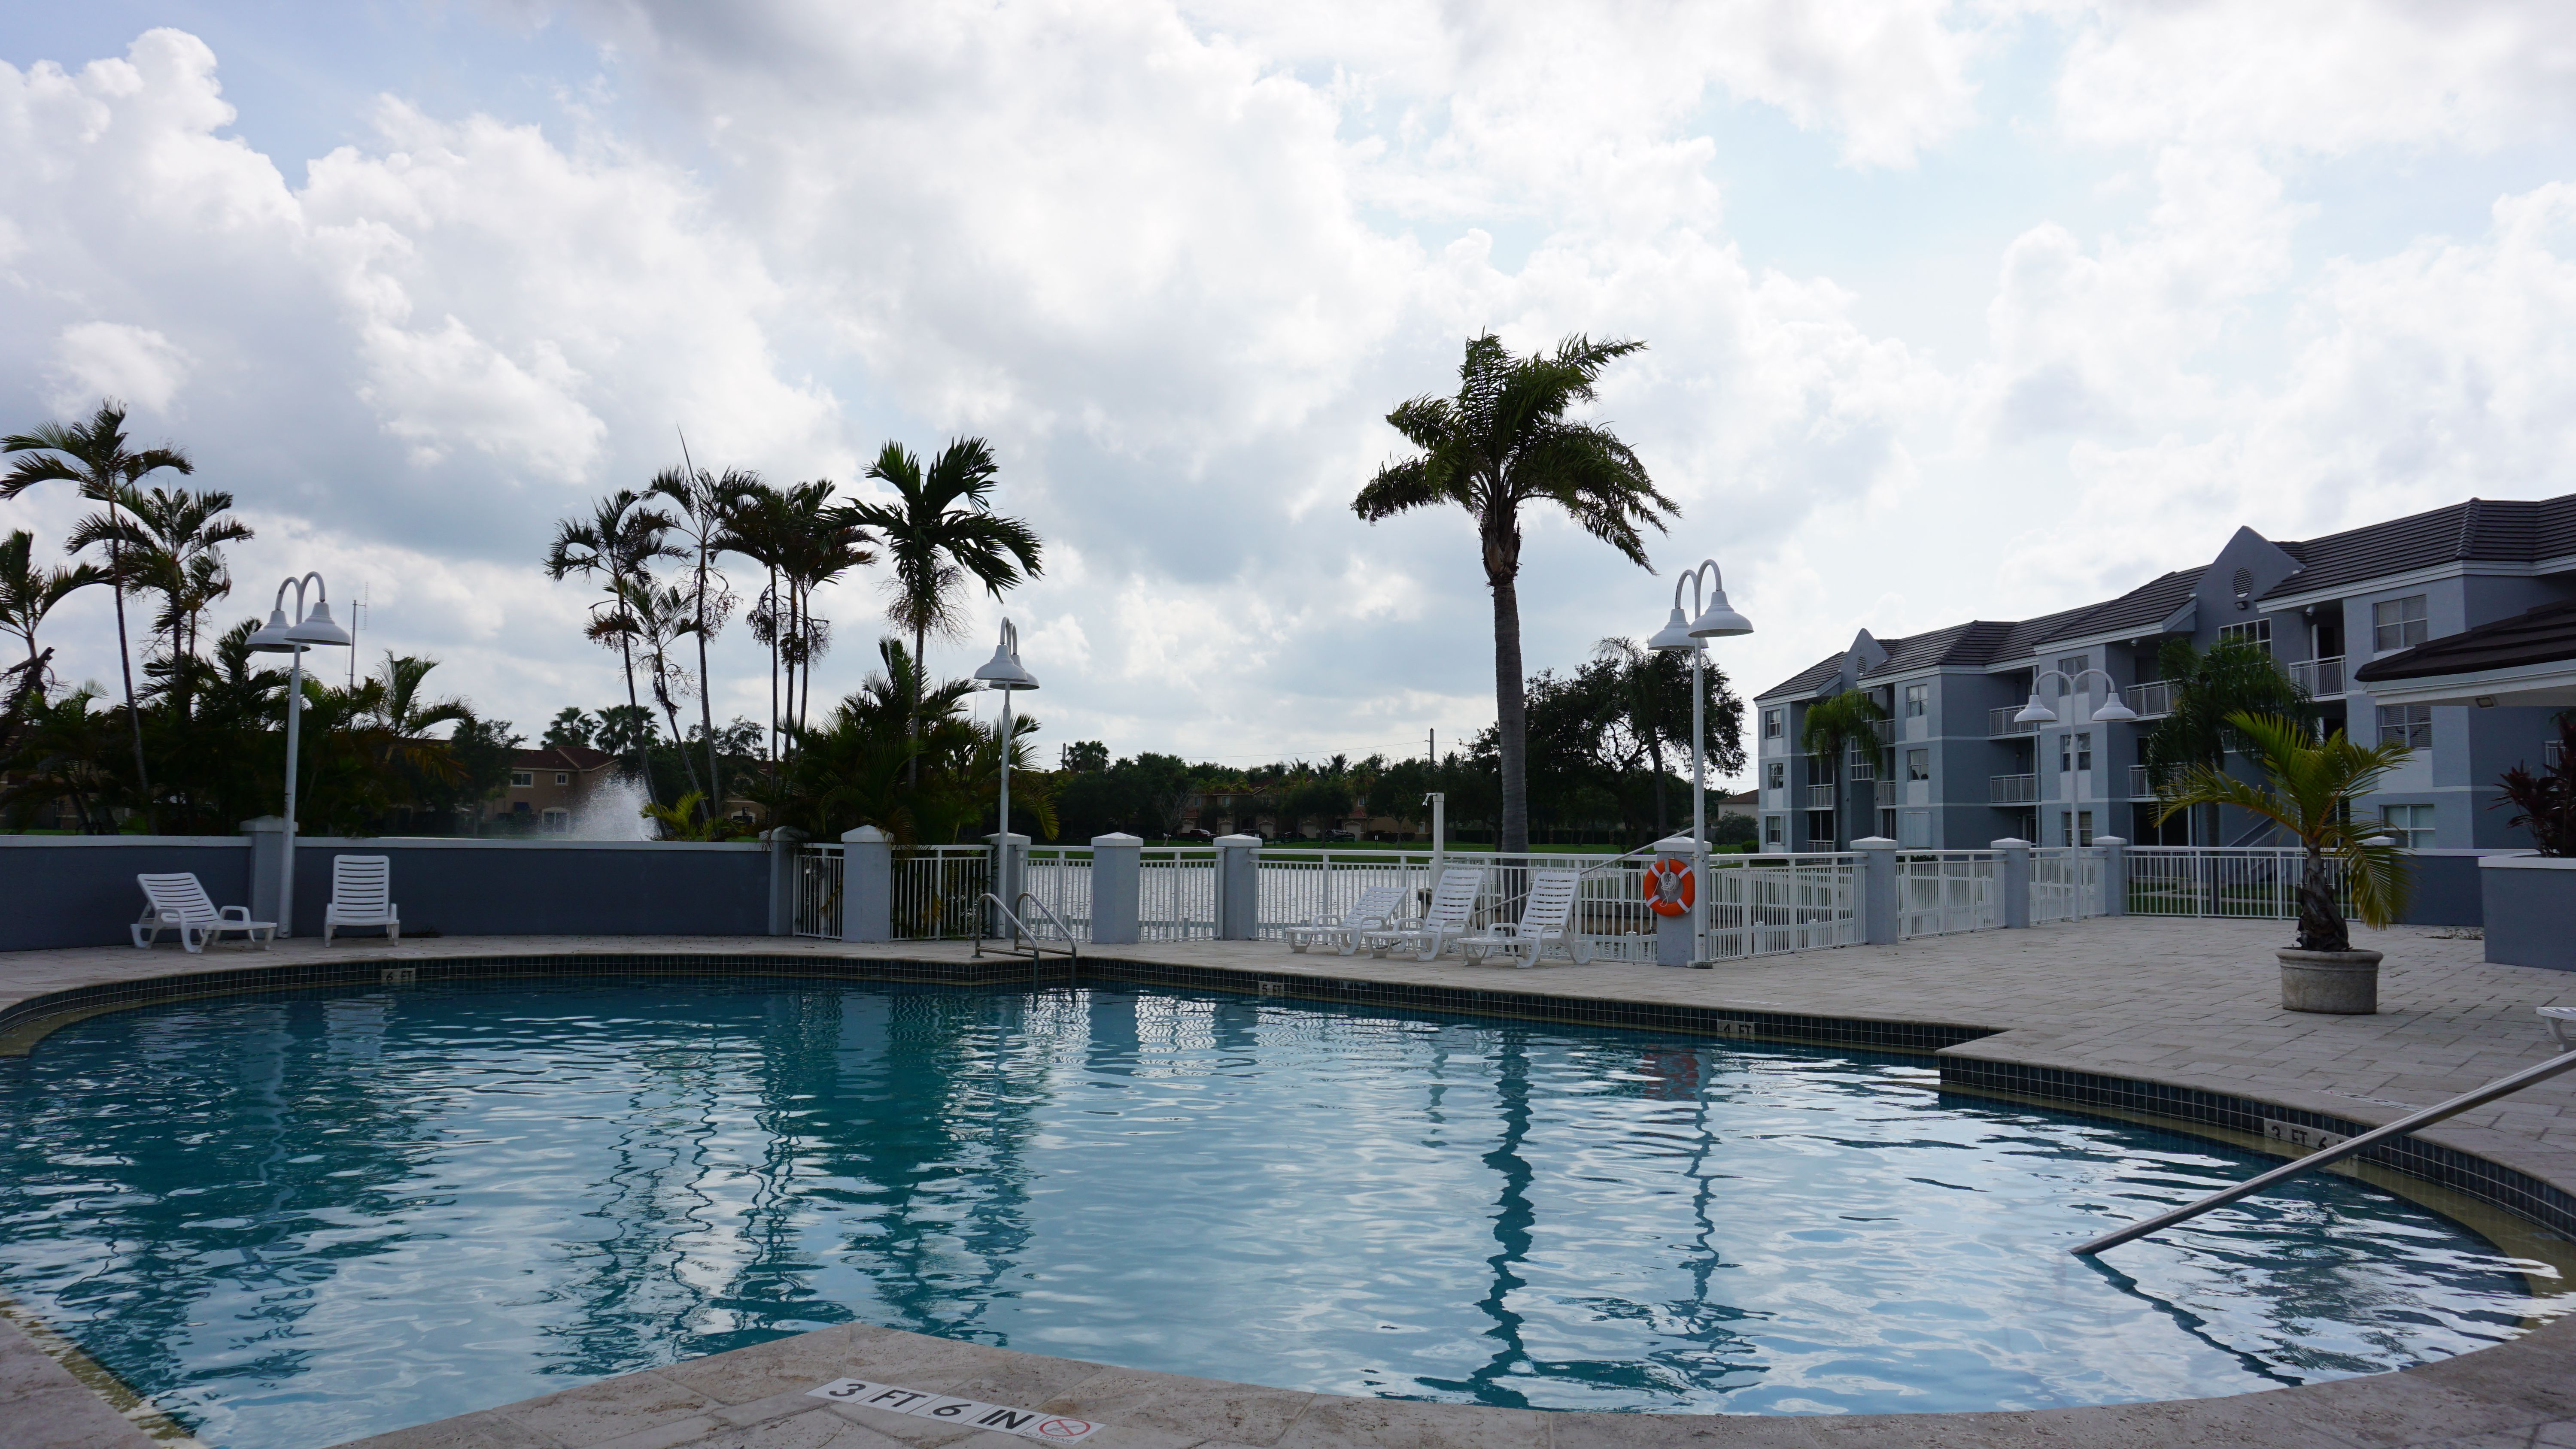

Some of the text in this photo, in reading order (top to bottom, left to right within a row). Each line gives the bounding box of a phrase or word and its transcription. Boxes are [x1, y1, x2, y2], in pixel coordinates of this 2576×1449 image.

[386, 971, 413, 981] 6 FT
[1262, 984, 1282, 993] 5 FT
[1739, 1025, 1751, 1034] FT
[2291, 1129, 2308, 1144] FT
[829, 1383, 1035, 1430] 3 FT 6 IN
[1039, 1434, 1075, 1444] DIVING
